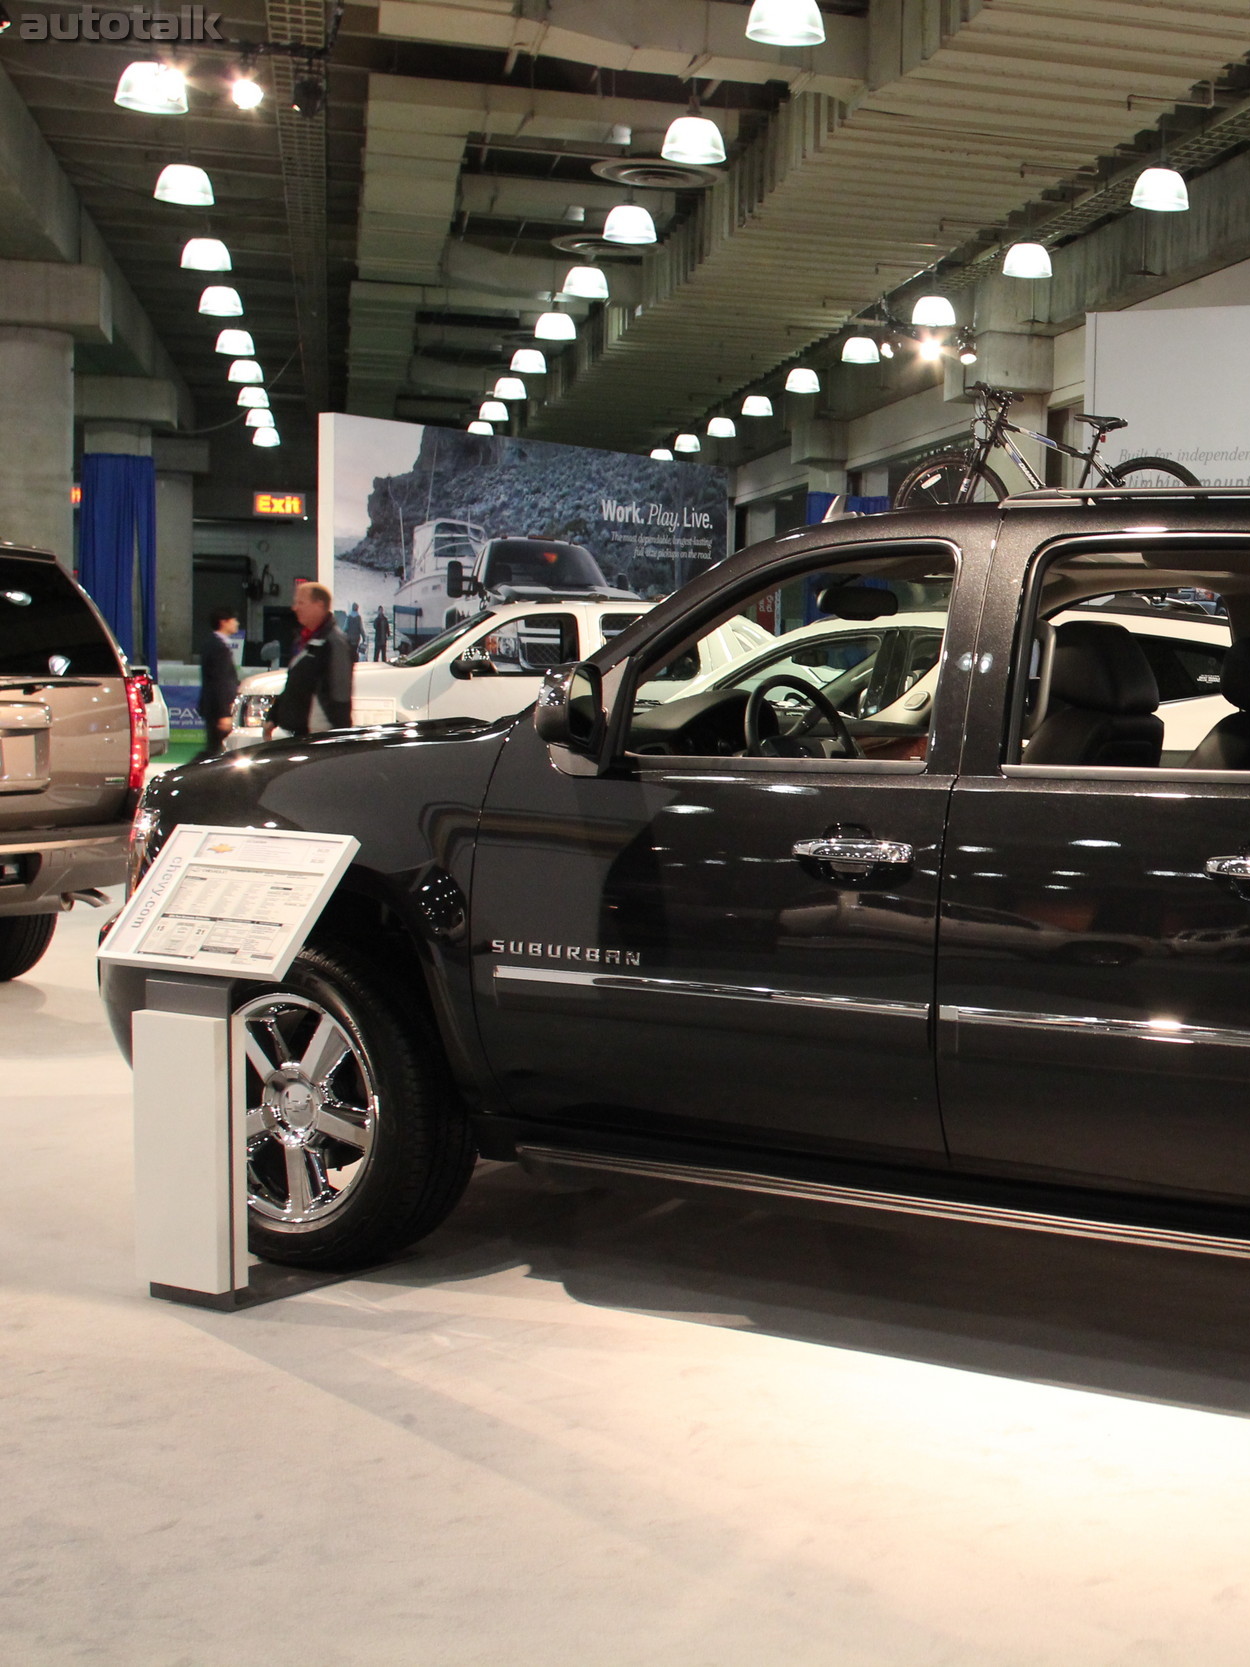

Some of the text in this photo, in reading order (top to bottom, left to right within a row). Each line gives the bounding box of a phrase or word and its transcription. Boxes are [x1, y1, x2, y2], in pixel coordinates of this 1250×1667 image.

[1119, 448, 1148, 462] Built
[1126, 474, 1183, 488] limbin
[256, 494, 302, 514] Exit
[602, 499, 713, 532] Work. Play. Live.
[611, 531, 622, 542] The
[131, 856, 183, 929] chevy.com
[491, 939, 641, 967] SUBURBAN
